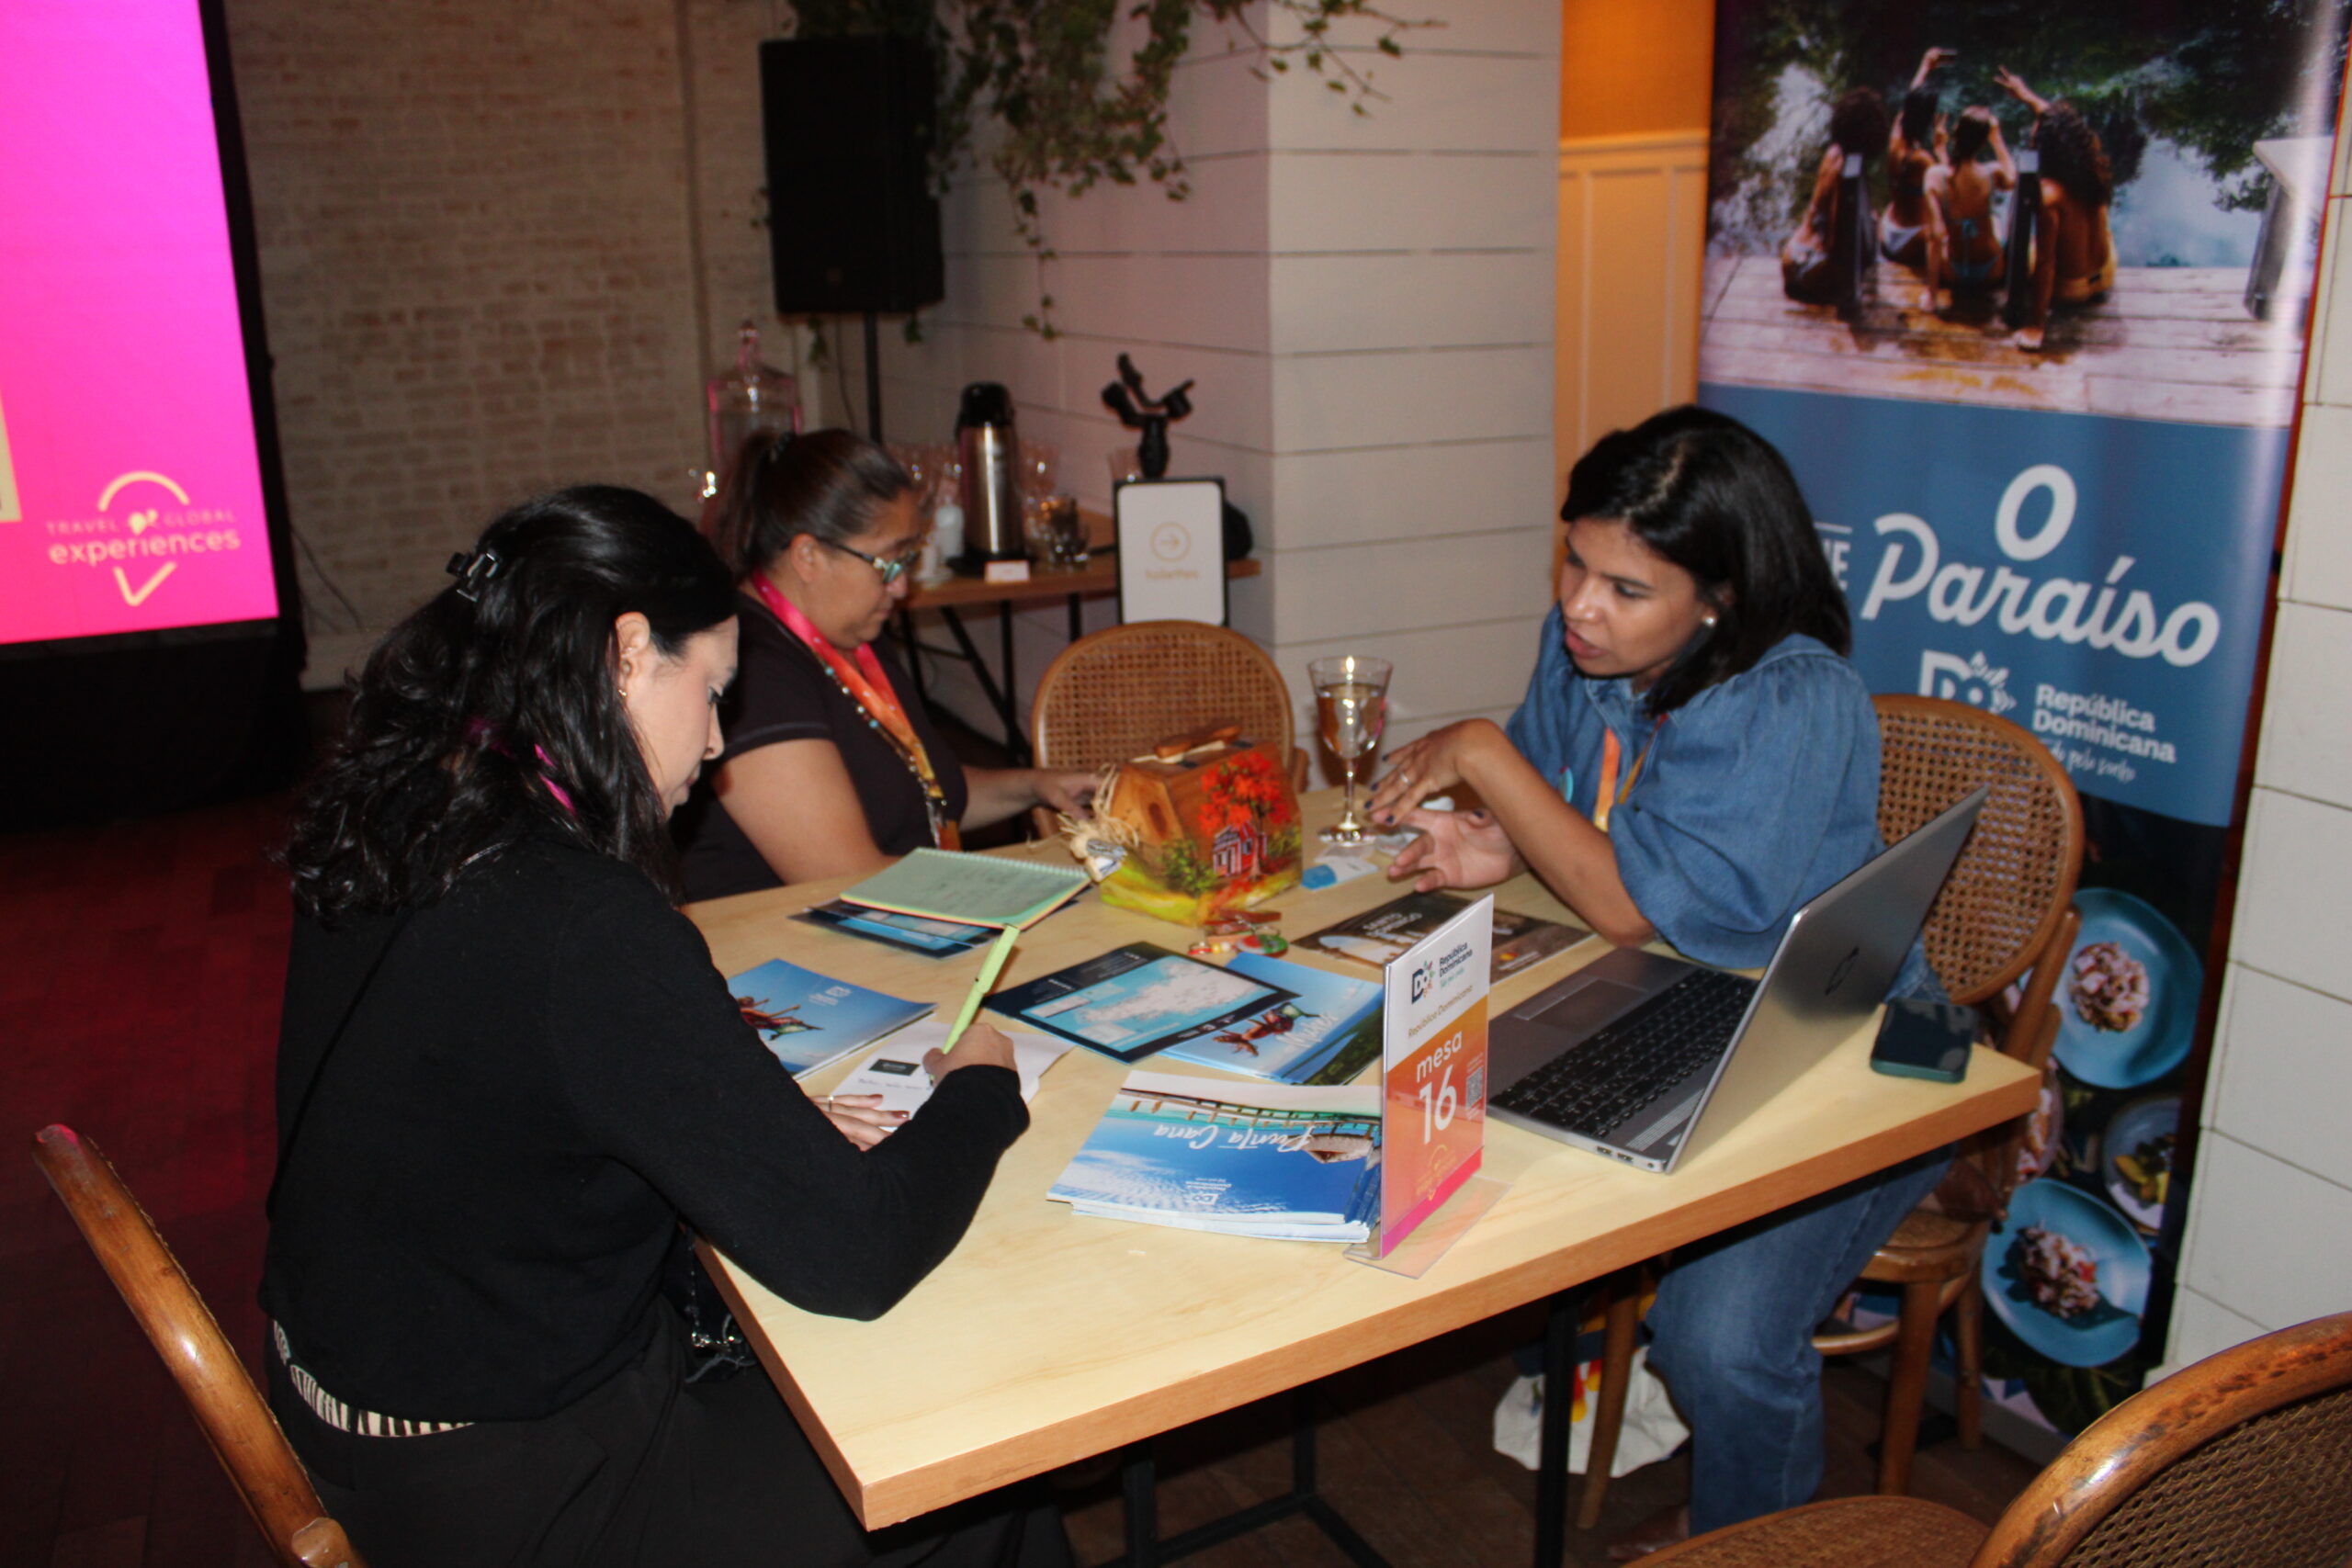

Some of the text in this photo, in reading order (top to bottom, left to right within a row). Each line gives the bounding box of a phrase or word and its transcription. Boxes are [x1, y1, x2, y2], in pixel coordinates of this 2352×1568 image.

[47, 509, 236, 536] TRAVEL GLOBAL
[1995, 463, 2077, 561] O
[49, 529, 242, 566] experiences
[1860, 512, 2220, 667] Paraíso
[2036, 683, 2156, 733] República
[2033, 708, 2177, 764] Dominicana
[1416, 1031, 1463, 1083] mesa
[1419, 1064, 1457, 1145] 16
[1153, 1124, 1316, 1153] Punta Cana
